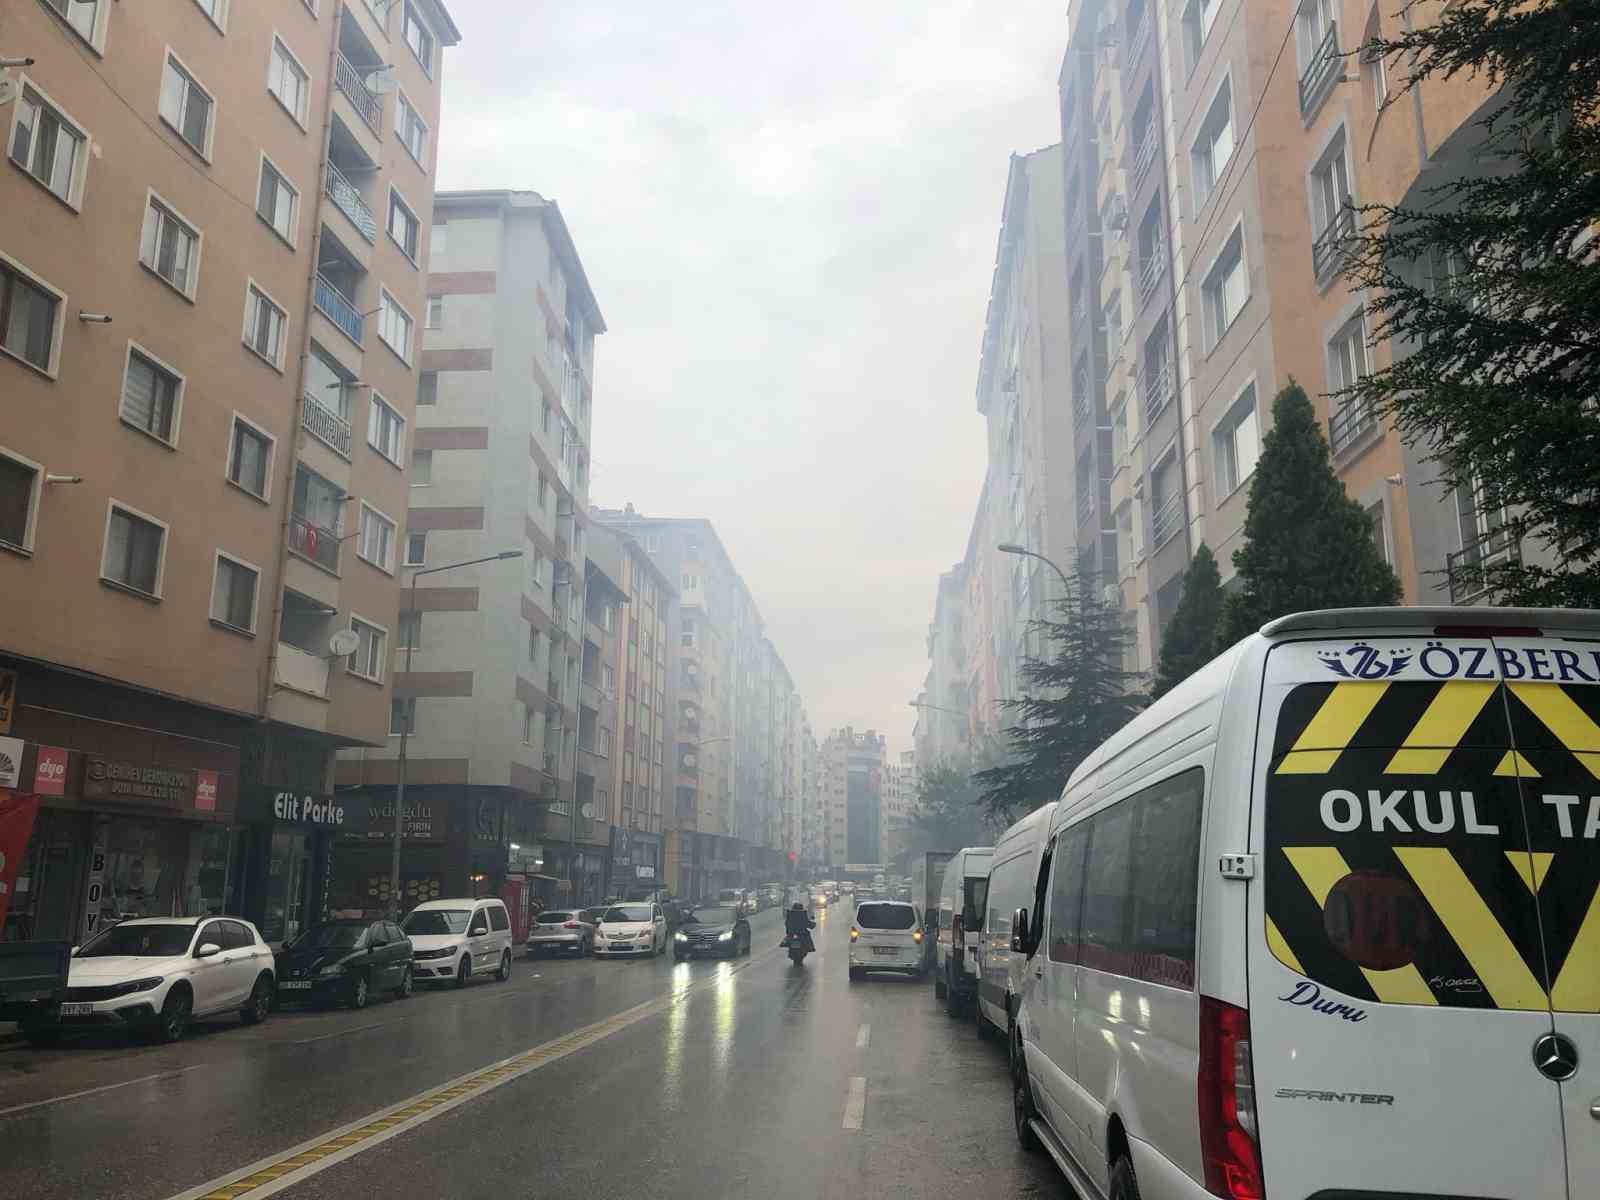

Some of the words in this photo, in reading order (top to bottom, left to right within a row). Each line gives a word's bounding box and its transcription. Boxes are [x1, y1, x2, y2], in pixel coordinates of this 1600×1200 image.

[1418, 641, 1600, 682] ÖZBER
[274, 792, 300, 822] Elit
[302, 795, 344, 825] Parke
[1319, 789, 1500, 835] OKUL
[1277, 980, 1369, 1023] Duru
[1274, 1087, 1395, 1107] SPRINTER
